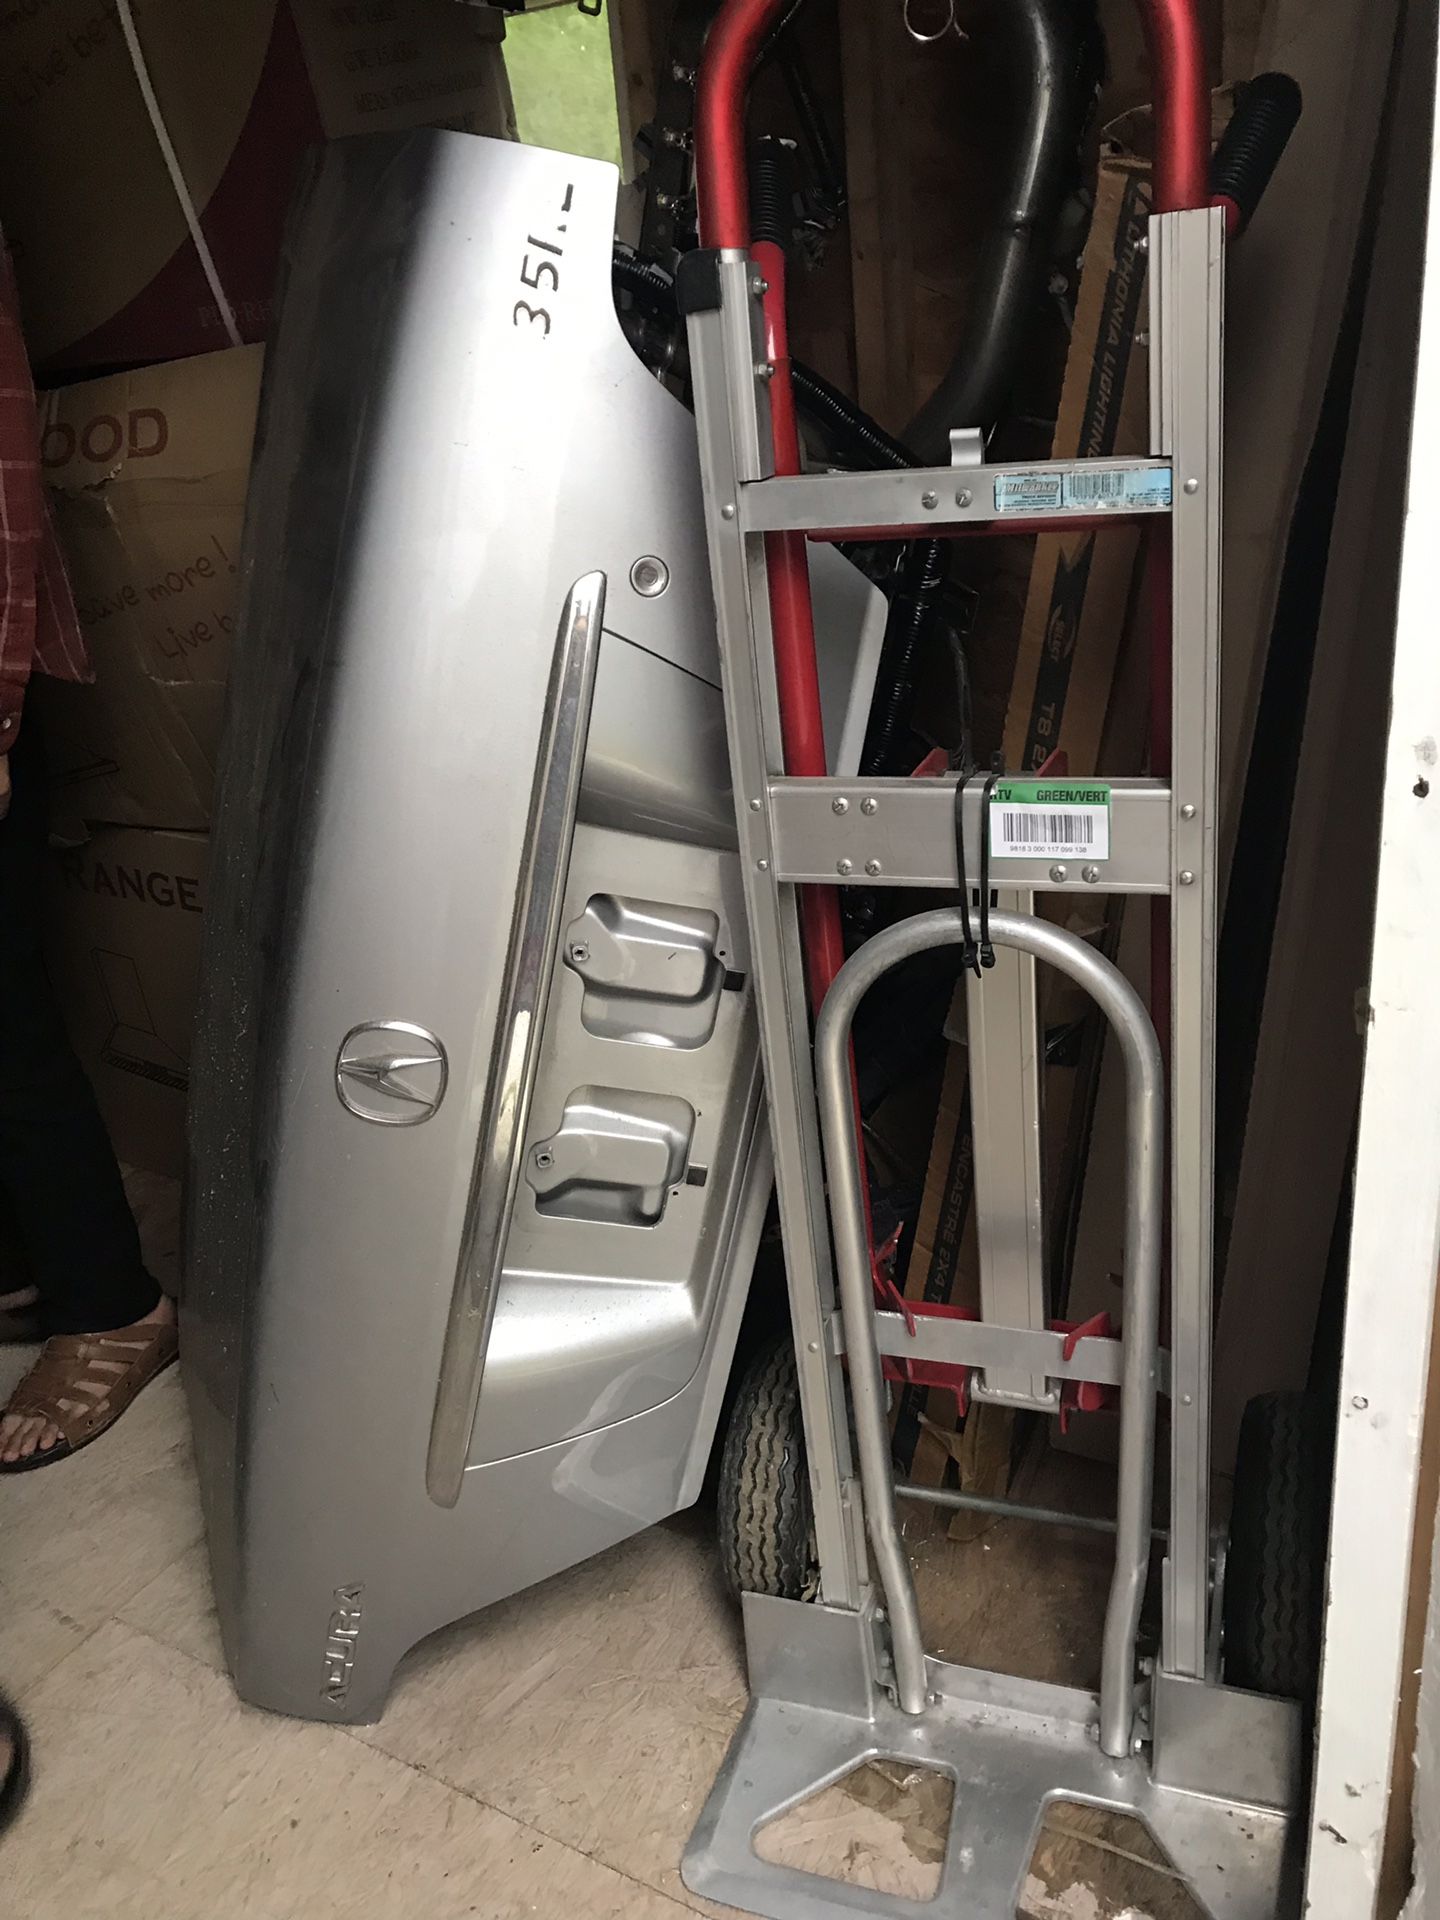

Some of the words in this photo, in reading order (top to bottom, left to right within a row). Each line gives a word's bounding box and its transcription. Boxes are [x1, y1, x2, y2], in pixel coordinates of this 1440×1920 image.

[41, 408, 169, 468] OOD
[152, 619, 214, 658] Live
[1037, 701, 1056, 737] T8
[1036, 789, 1108, 802] GREEN/VERT
[943, 1133, 973, 1247] ENCASTRÉ
[319, 1581, 366, 1710] ACURA
